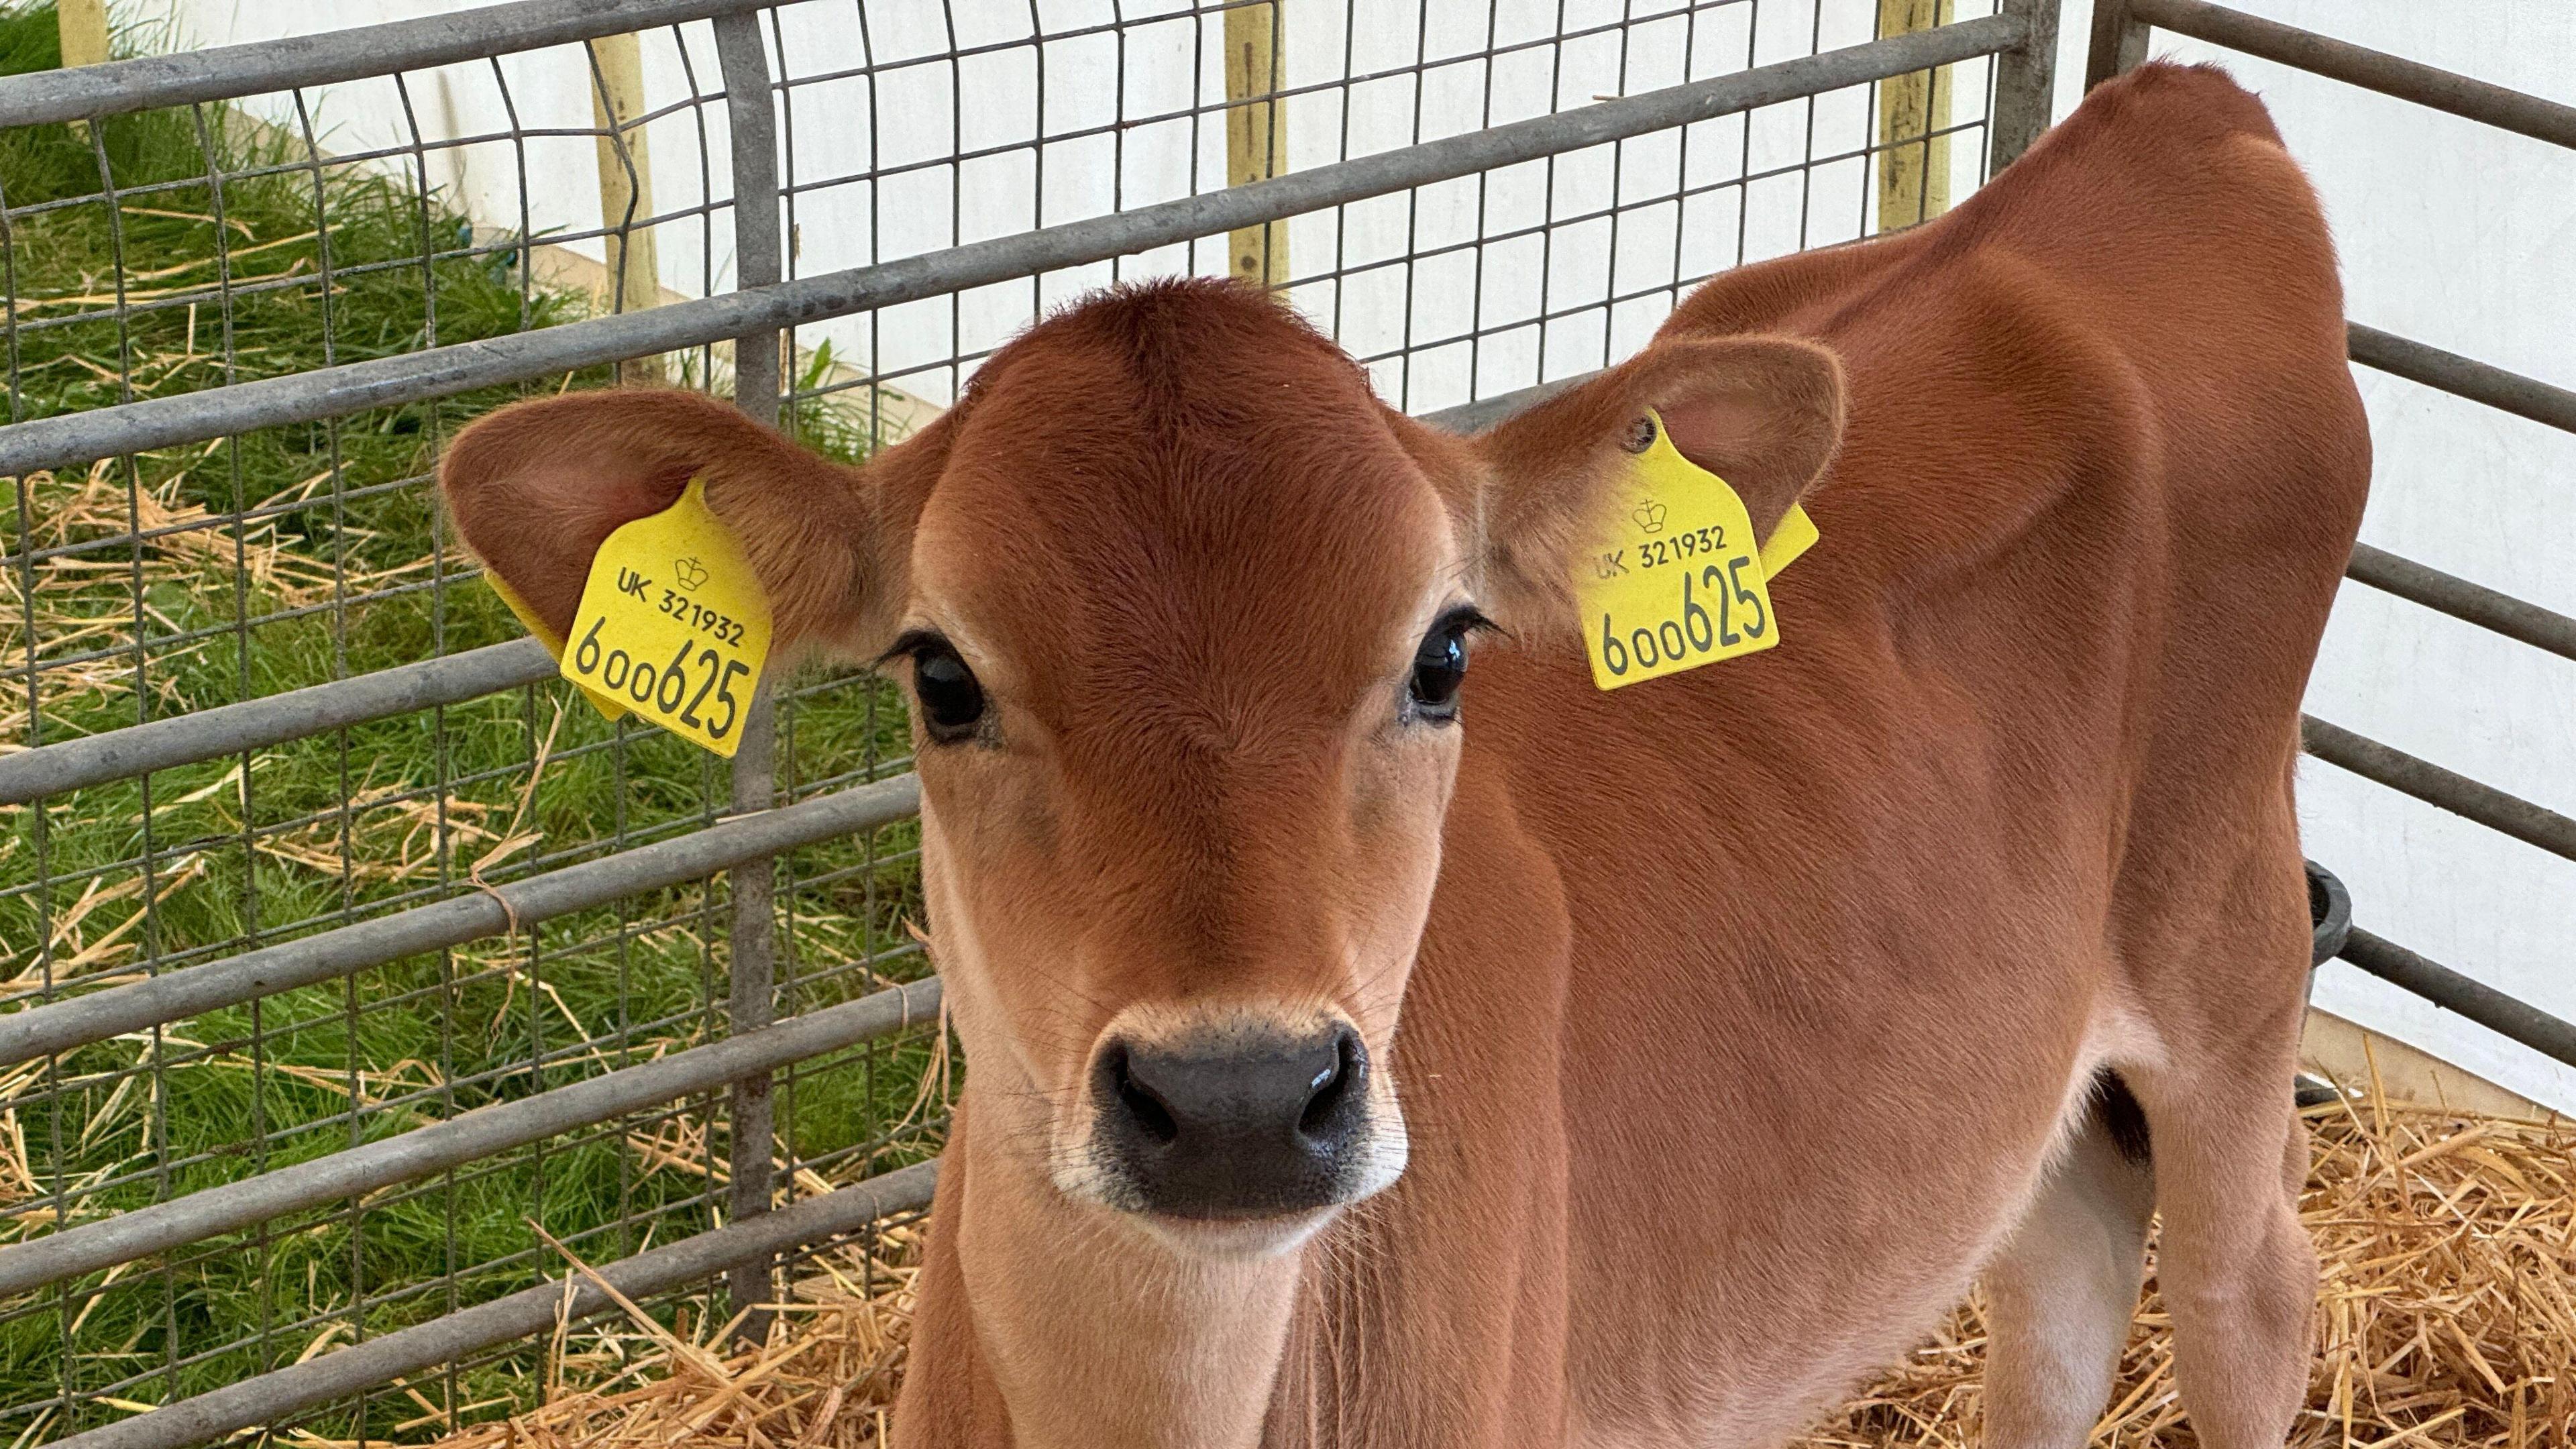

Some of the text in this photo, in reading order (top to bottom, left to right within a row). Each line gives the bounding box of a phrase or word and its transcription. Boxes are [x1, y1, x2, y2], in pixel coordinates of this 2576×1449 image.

[1638, 525, 1727, 569] 321932
[617, 566, 745, 648] UK 321932
[1603, 556, 1766, 676] 600625
[576, 616, 750, 739] 600625
